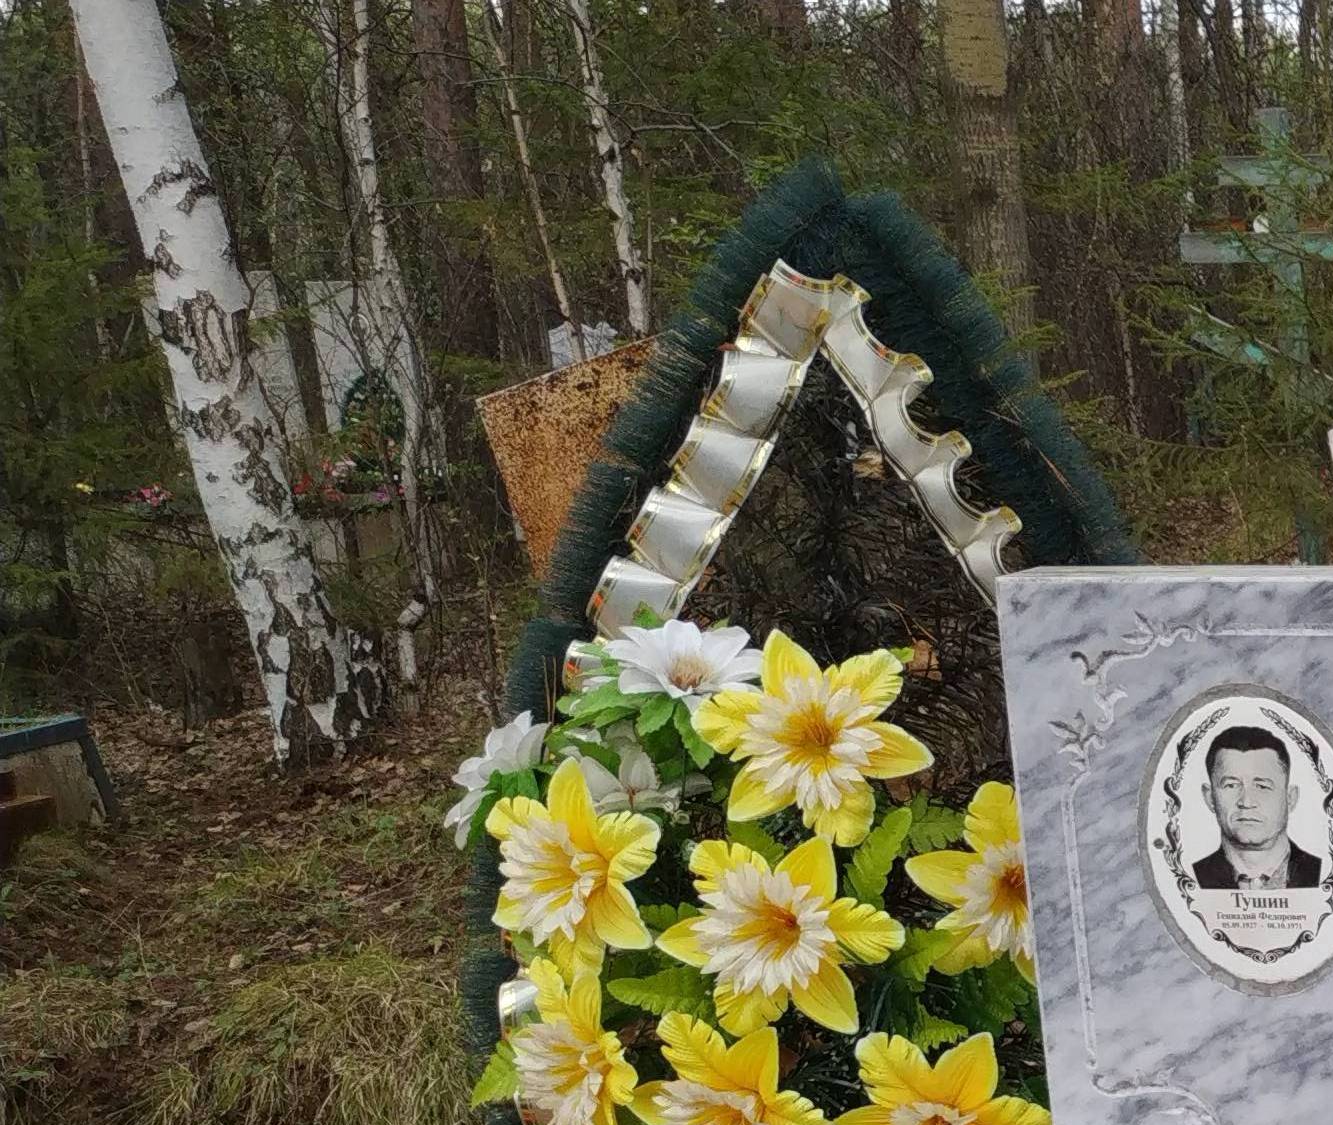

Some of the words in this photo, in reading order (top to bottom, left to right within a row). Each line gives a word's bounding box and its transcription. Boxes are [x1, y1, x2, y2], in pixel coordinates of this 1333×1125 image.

[1230, 892, 1289, 911] Тушин
[1216, 911, 1256, 920] Геннадий
[1258, 911, 1306, 922] Федорович
